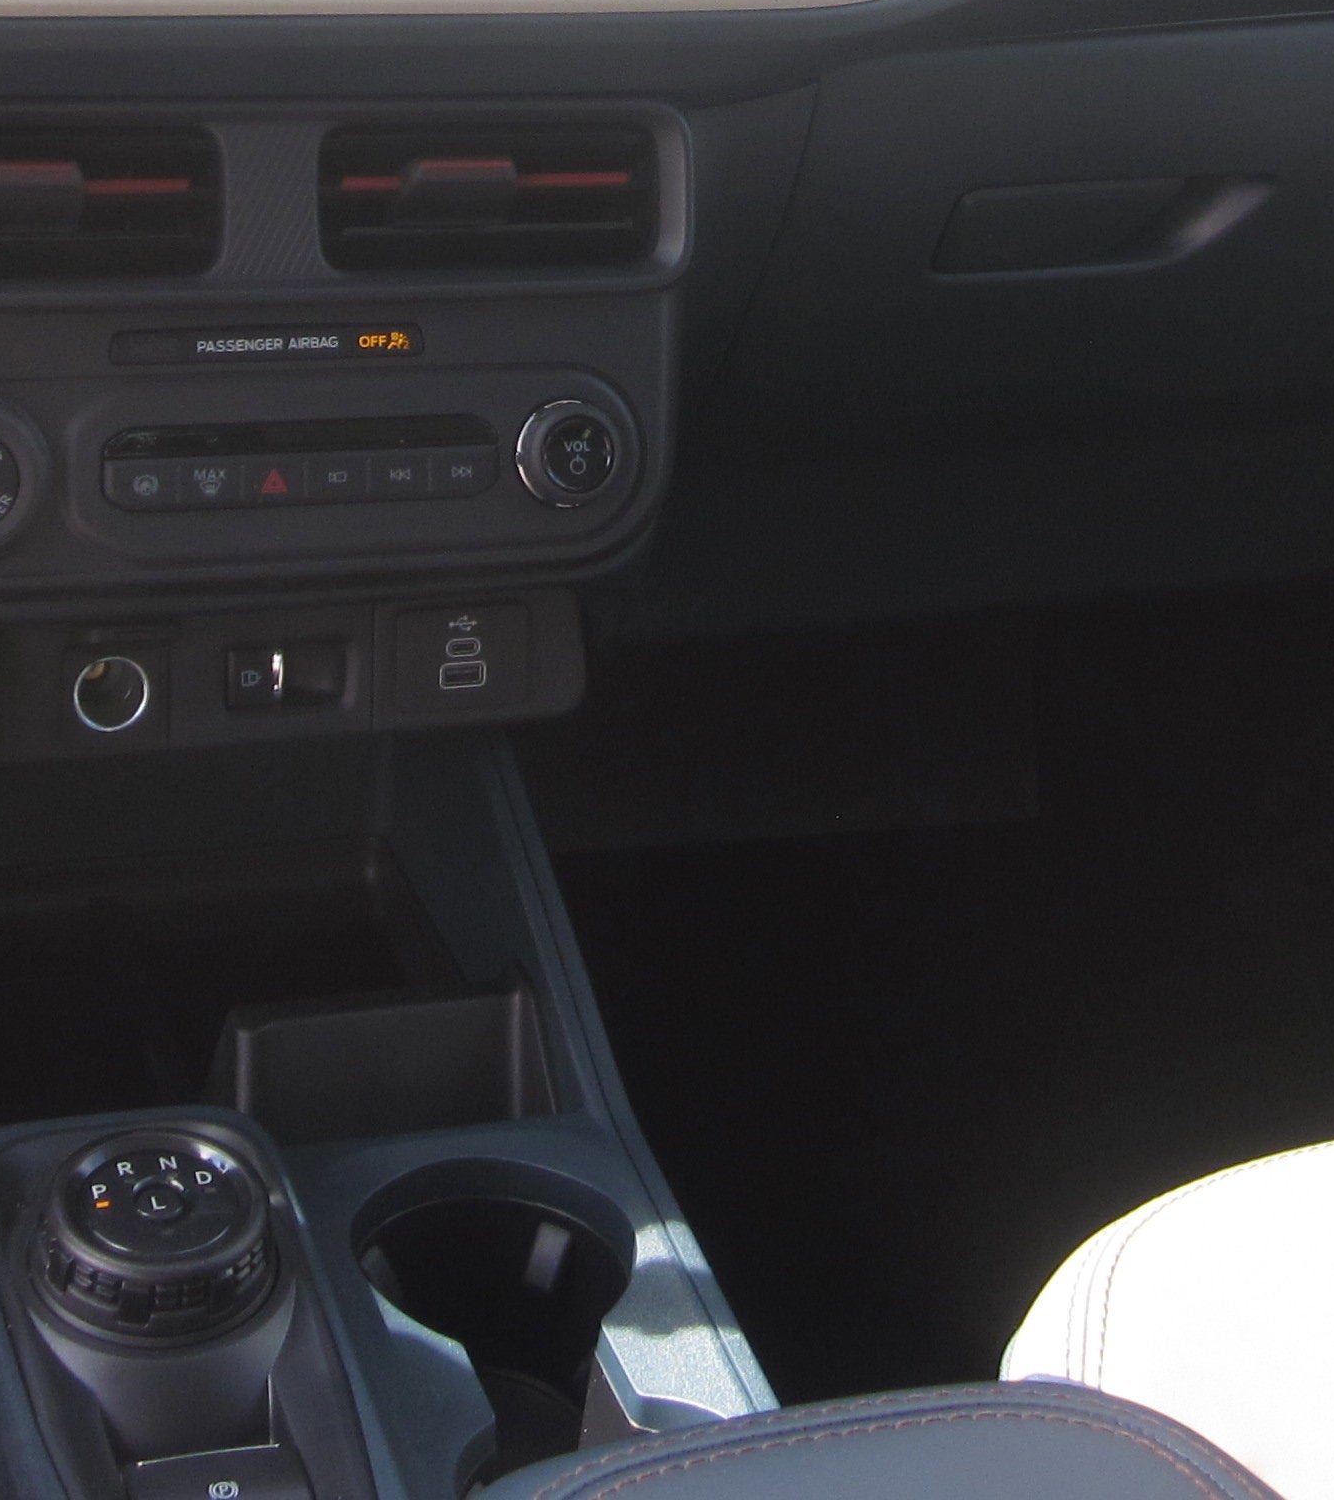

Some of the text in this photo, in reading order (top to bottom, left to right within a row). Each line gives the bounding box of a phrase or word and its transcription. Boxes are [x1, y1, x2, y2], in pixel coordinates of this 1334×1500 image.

[196, 334, 387, 353] PASSENGER AIRBAG OFF
[563, 440, 591, 452] VOL
[192, 468, 227, 481] MAX
[90, 1155, 213, 1200] P R N D
[150, 1195, 167, 1211] L
